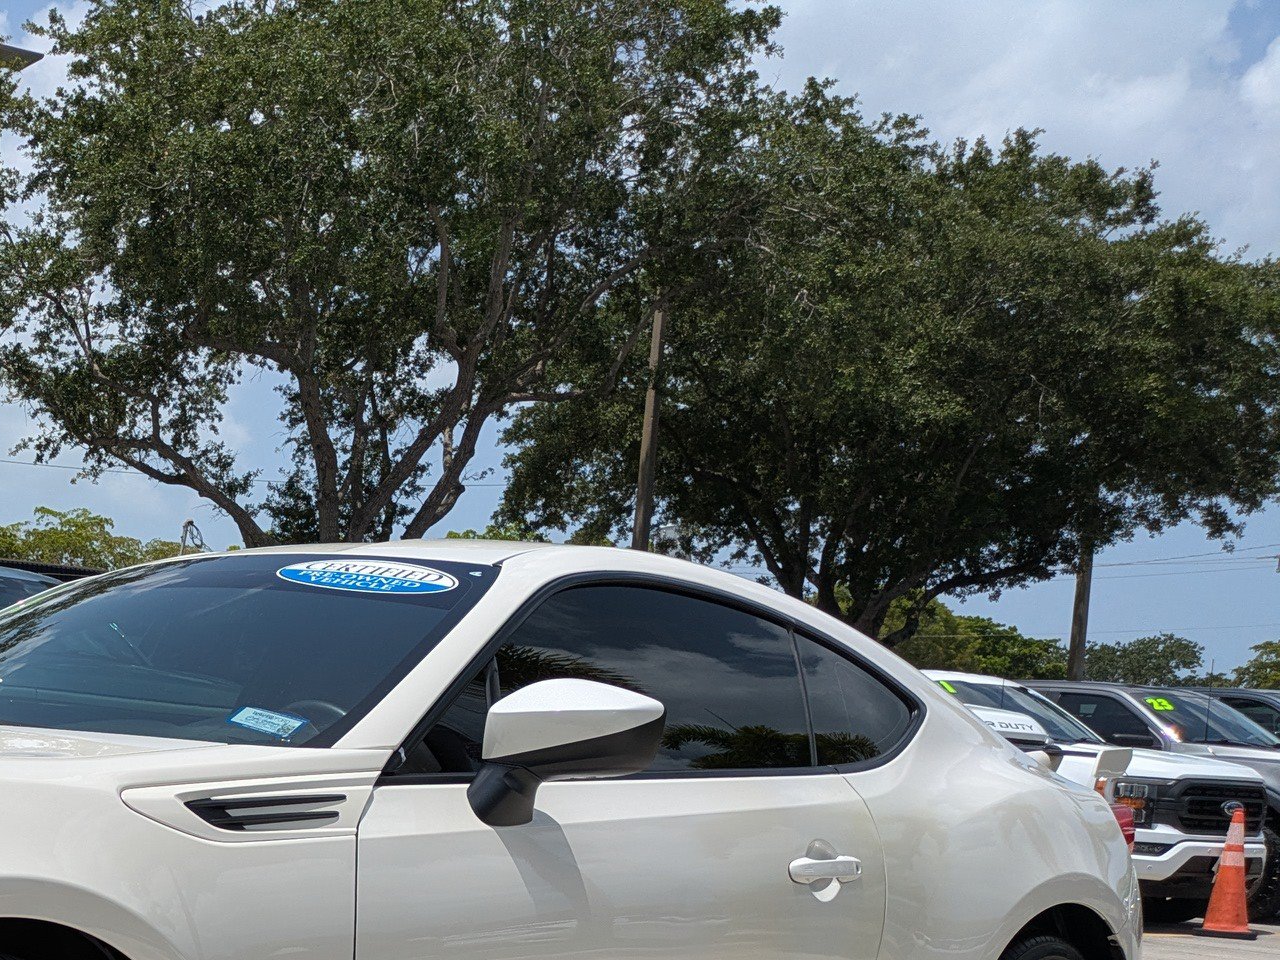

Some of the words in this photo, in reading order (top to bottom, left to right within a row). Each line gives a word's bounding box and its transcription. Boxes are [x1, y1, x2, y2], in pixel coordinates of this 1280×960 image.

[297, 570, 421, 588] PRE-OWNED
[305, 561, 444, 582] CERTIFIED
[310, 575, 395, 591] VEHICLE
[1144, 697, 1175, 711] 23
[1000, 721, 1034, 731] DUTY
